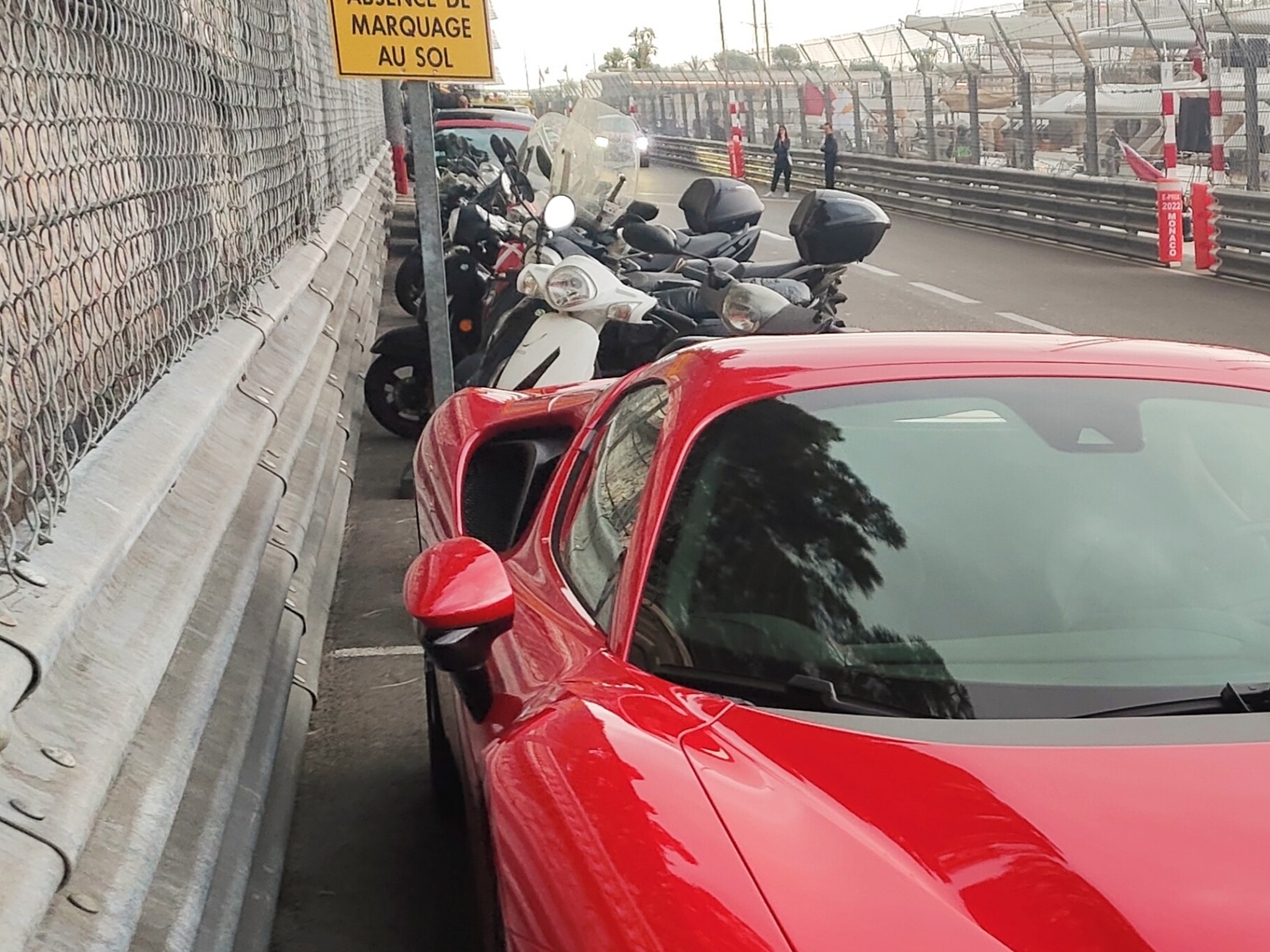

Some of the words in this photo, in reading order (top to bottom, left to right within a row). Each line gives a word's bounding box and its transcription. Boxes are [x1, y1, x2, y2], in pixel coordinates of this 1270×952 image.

[352, 14, 472, 39] MARQUAGE
[378, 45, 406, 67] AU
[416, 46, 454, 68] SOL
[1161, 201, 1181, 211] 2022
[1167, 212, 1178, 257] MONACO
